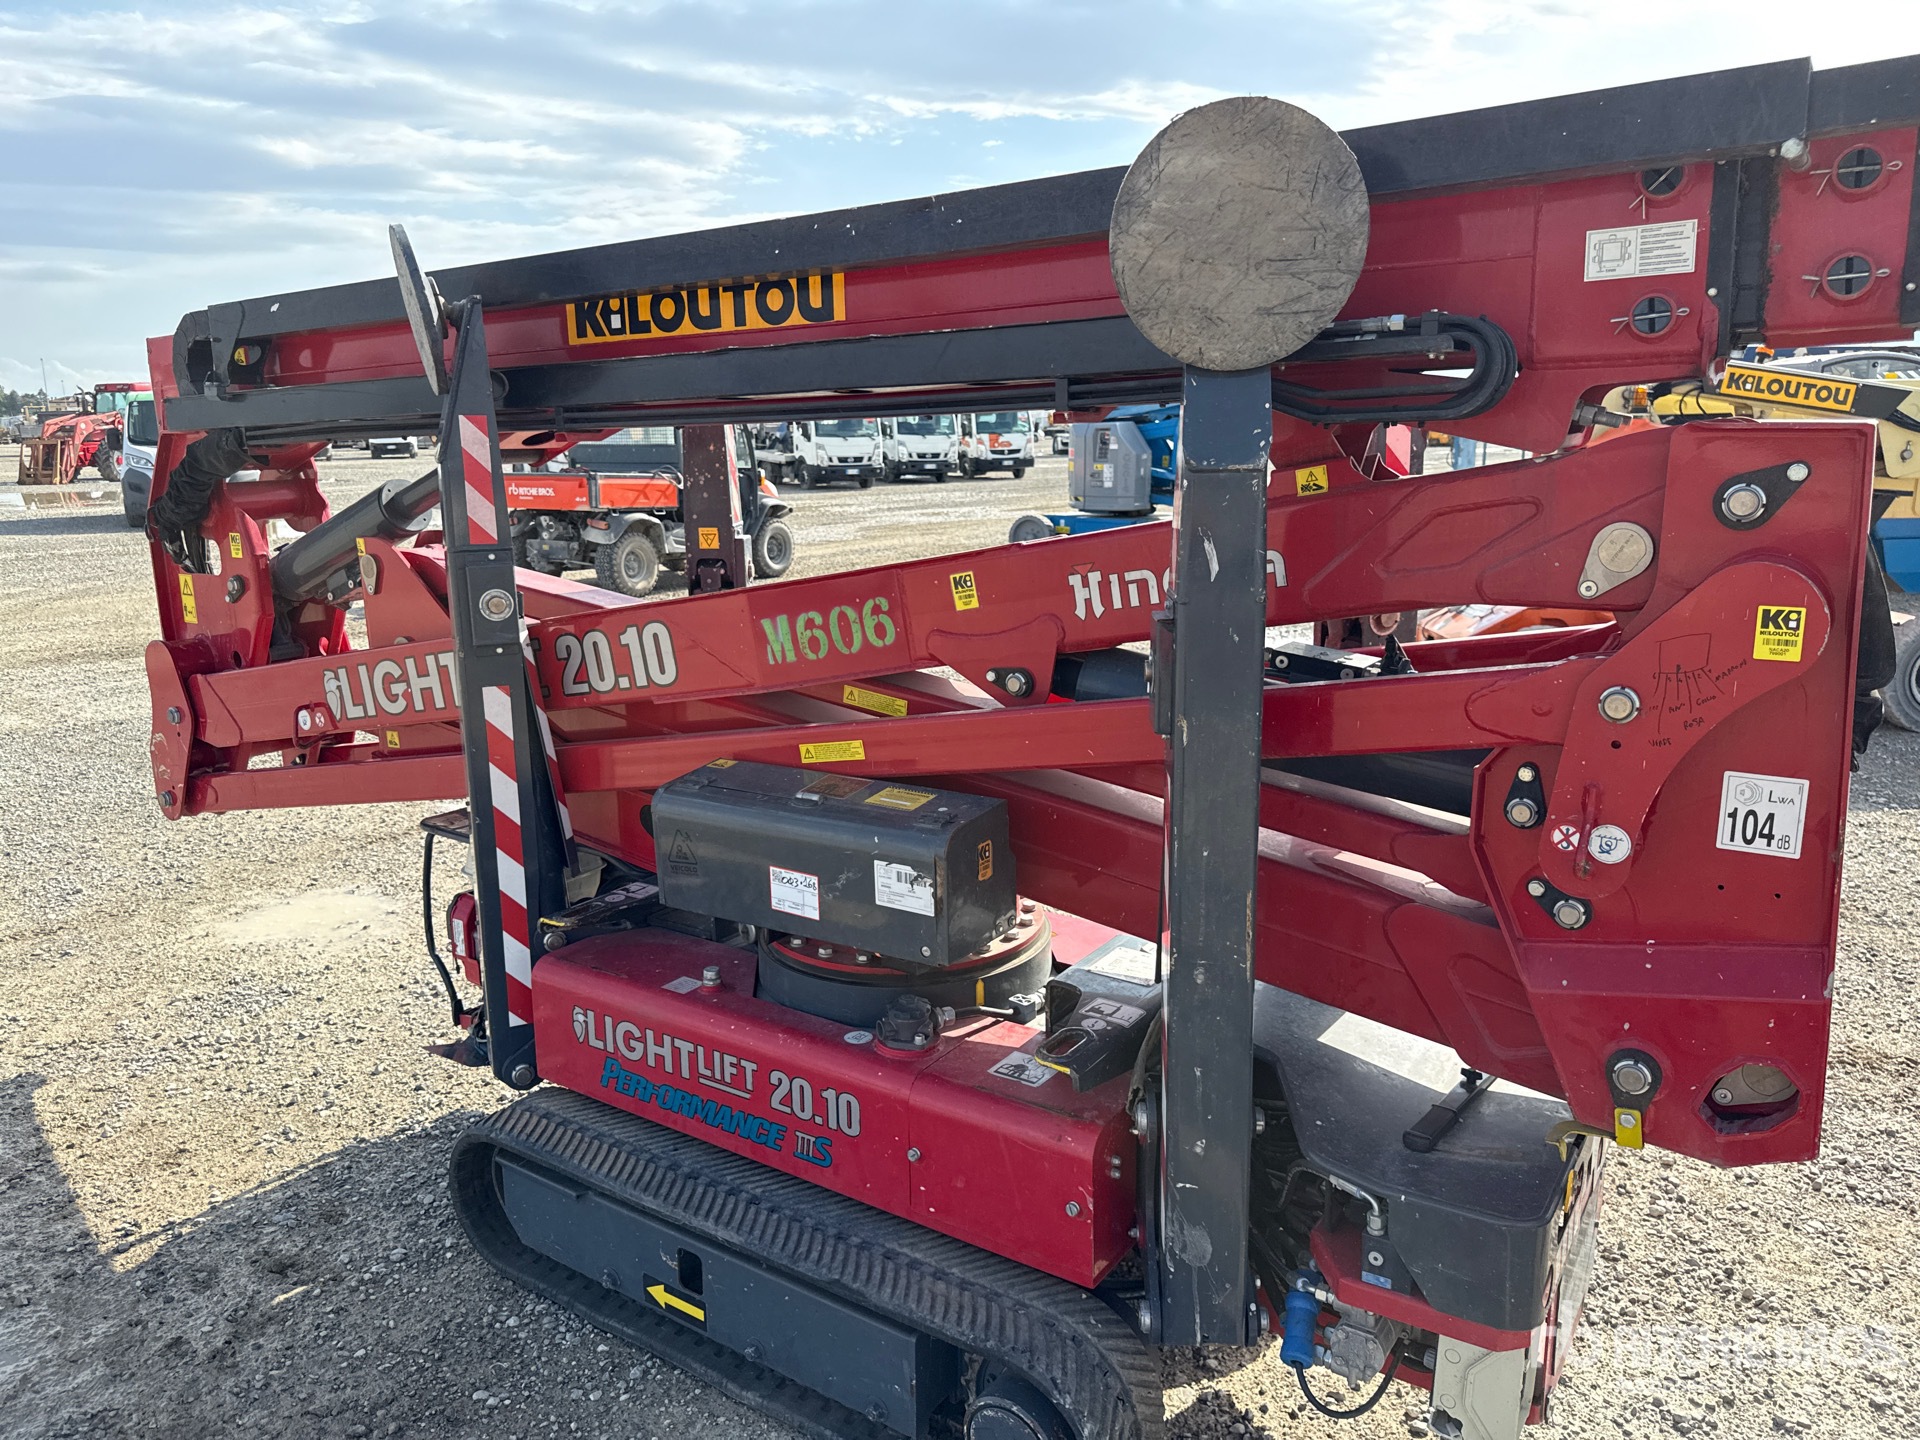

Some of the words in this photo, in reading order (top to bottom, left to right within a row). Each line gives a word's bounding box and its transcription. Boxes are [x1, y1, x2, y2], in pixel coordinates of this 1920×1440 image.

[555, 622, 678, 695] 20.10
[761, 596, 896, 665] M606
[1727, 807, 1775, 847] 104
[1776, 835, 1791, 850] dB
[600, 1056, 787, 1151] PERFORMANCE
[769, 1070, 860, 1137] 20.10
